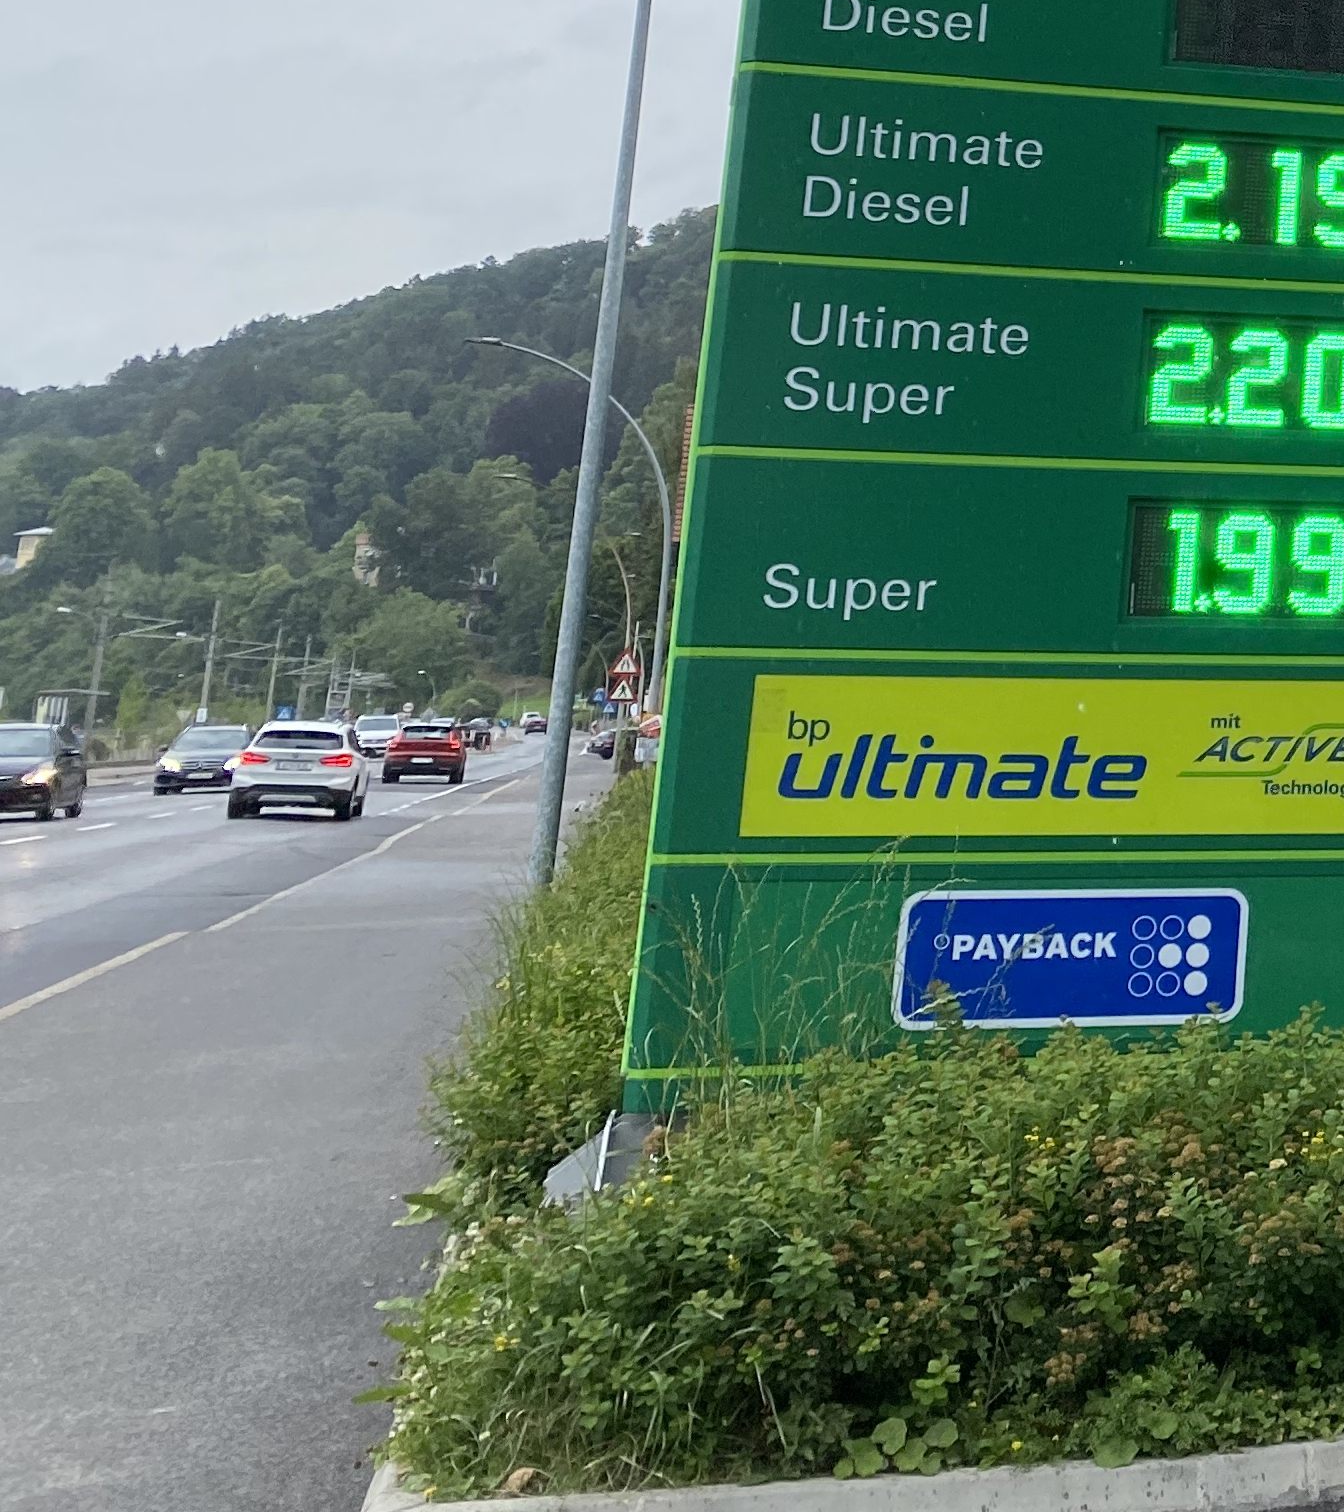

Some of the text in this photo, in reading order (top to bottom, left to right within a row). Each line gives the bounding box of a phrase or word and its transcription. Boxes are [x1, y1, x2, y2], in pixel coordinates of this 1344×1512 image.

[808, 112, 1044, 170] Ultimate
[802, 174, 970, 227] Diesel
[789, 301, 1030, 357] Ultimate
[783, 366, 954, 423] Super
[761, 563, 937, 621] Super
[787, 710, 831, 747] bp
[1209, 713, 1242, 731] mit
[777, 734, 1148, 800] ultimate
[950, 931, 1117, 963] PAYBACK
